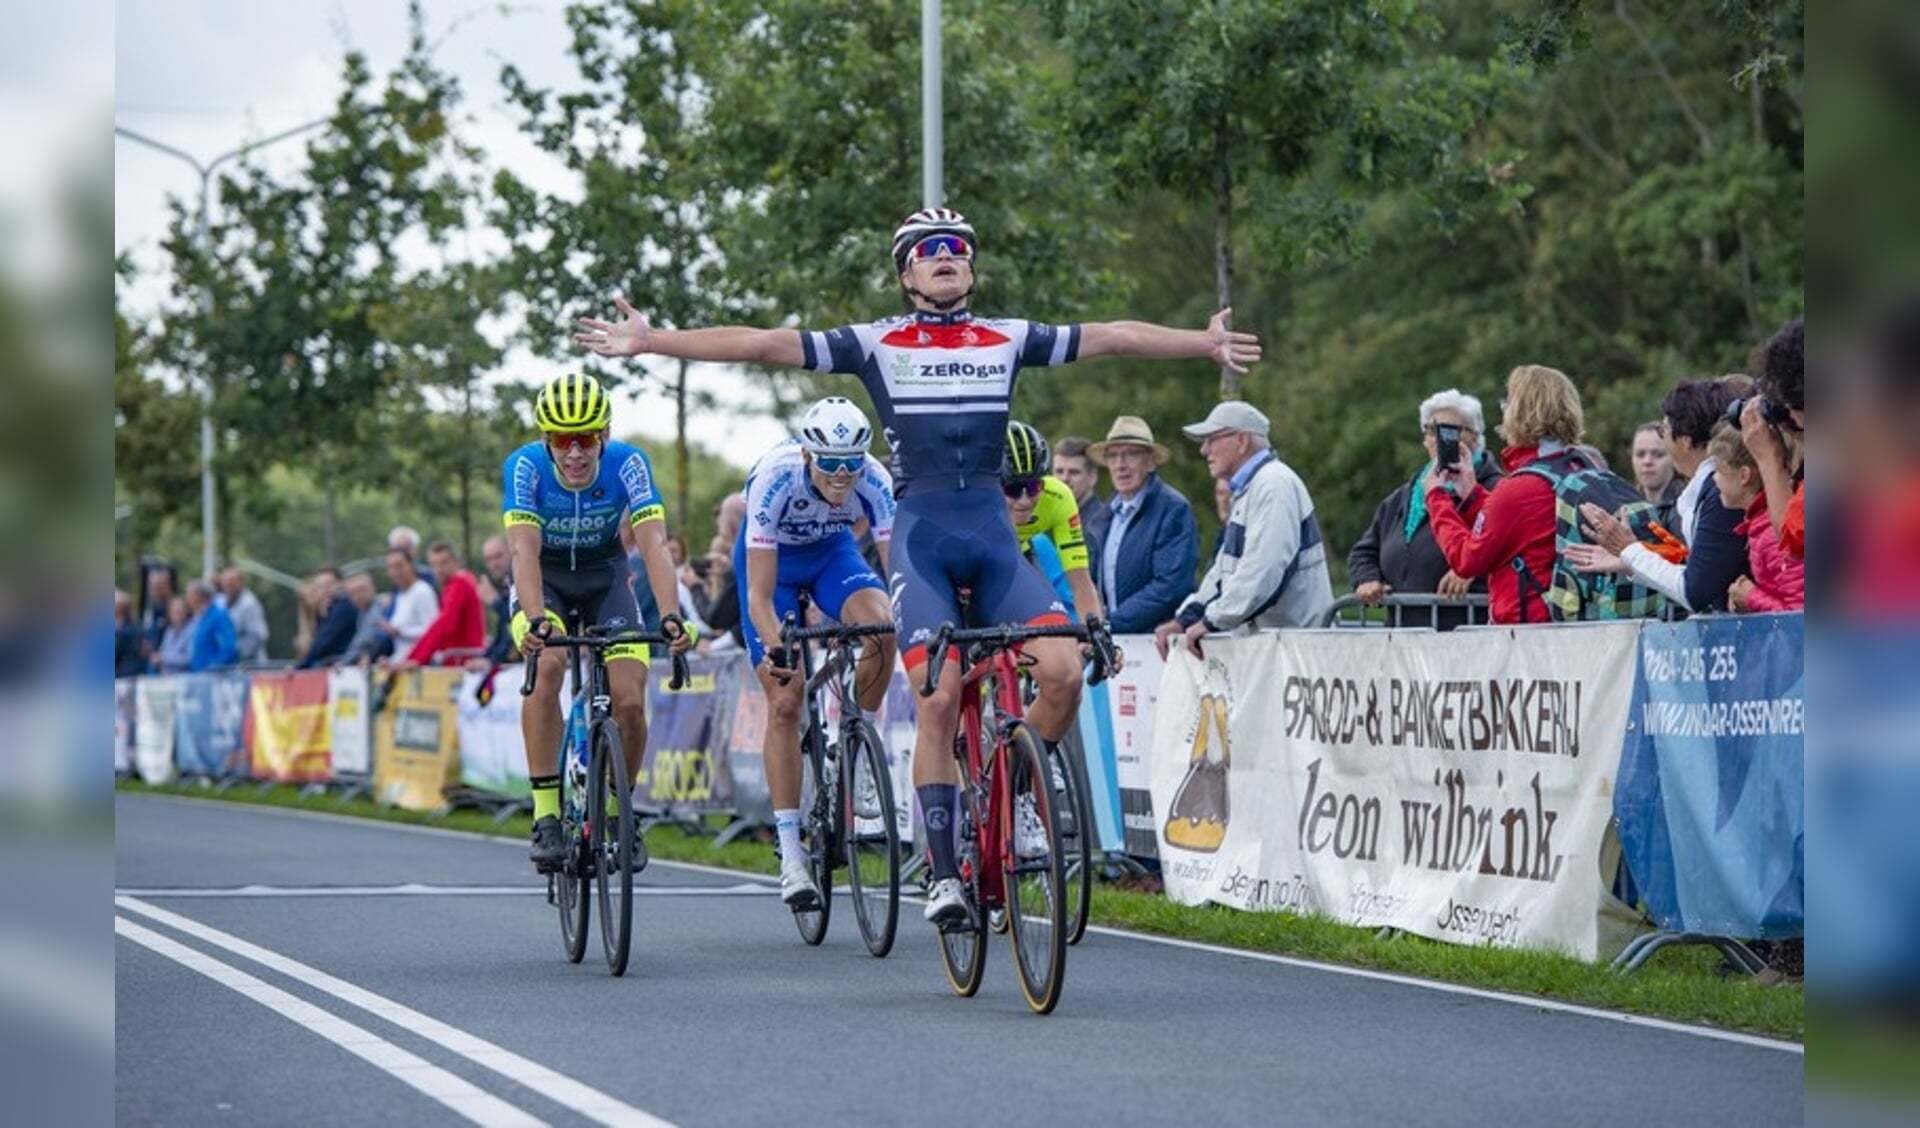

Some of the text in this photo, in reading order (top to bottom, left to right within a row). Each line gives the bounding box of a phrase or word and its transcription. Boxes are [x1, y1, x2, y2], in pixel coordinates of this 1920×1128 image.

[920, 362, 1007, 379] ZEROgas
[1709, 644, 1738, 681] 255
[1299, 758, 1382, 860] leon
